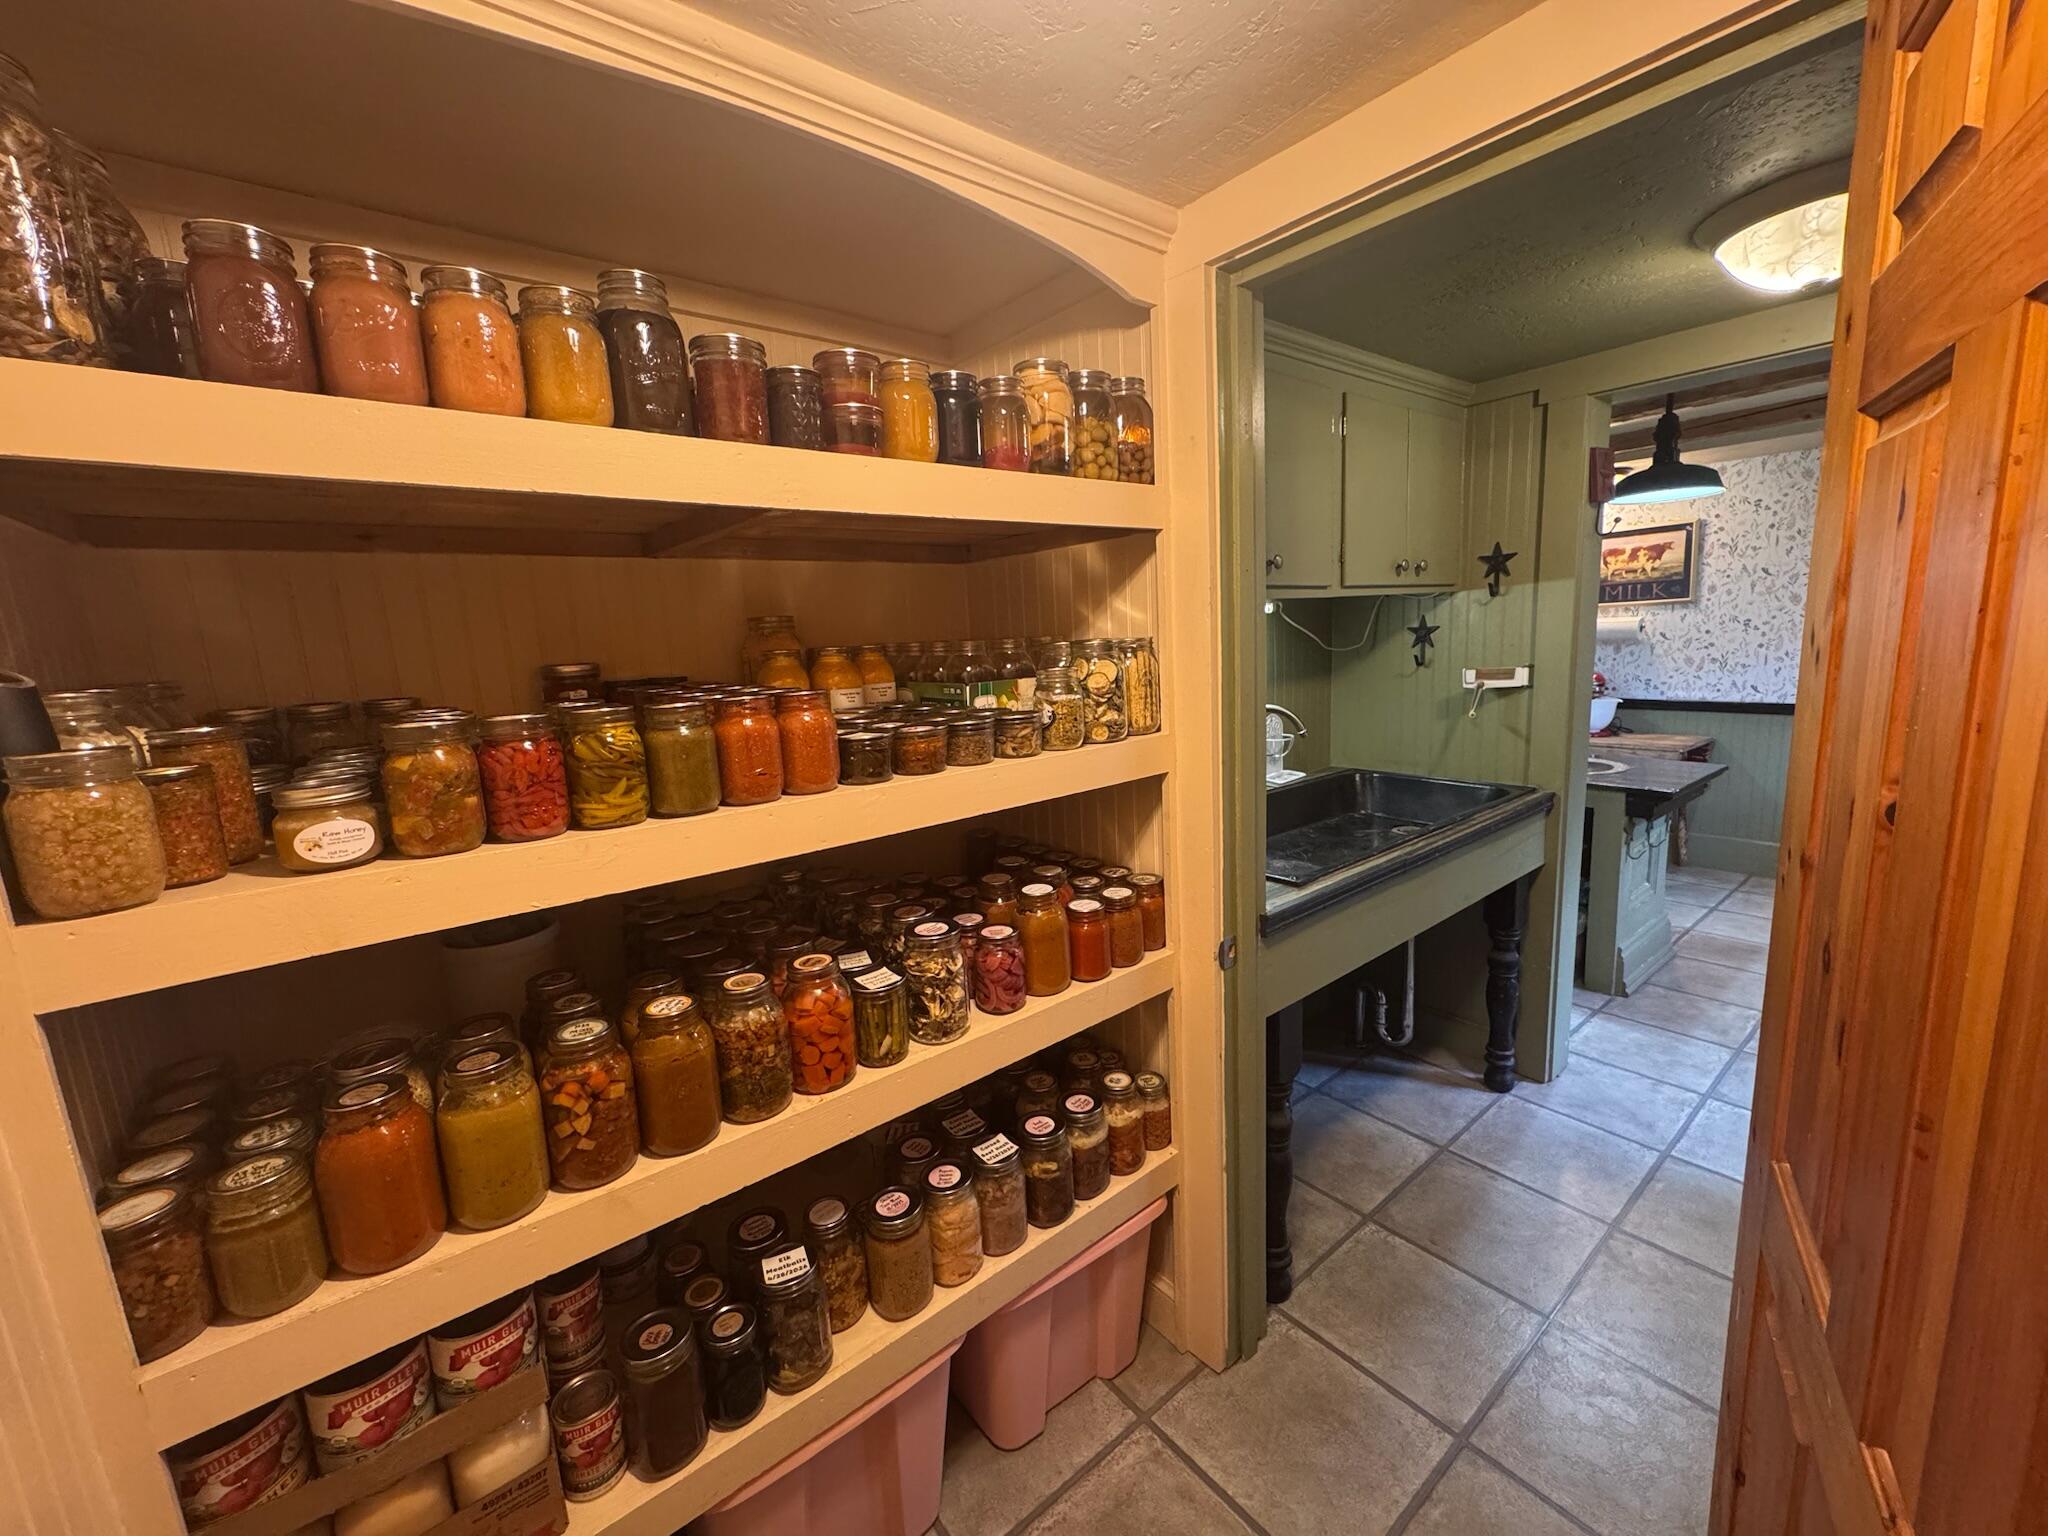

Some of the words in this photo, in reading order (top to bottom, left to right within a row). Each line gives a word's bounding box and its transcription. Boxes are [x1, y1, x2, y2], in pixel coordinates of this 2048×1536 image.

[1605, 583, 1667, 600] MILK
[344, 826, 367, 837] Honey
[980, 1139, 1001, 1151] Corned
[765, 1257, 806, 1275] Meatballs
[778, 1254, 791, 1263] Elk
[461, 1334, 496, 1359] MUIR
[502, 1311, 530, 1337] GLEN
[341, 1388, 381, 1415] MUIR
[387, 1359, 420, 1390] GLEN
[565, 1425, 591, 1441] MUIR
[194, 1449, 240, 1483] MUIR
